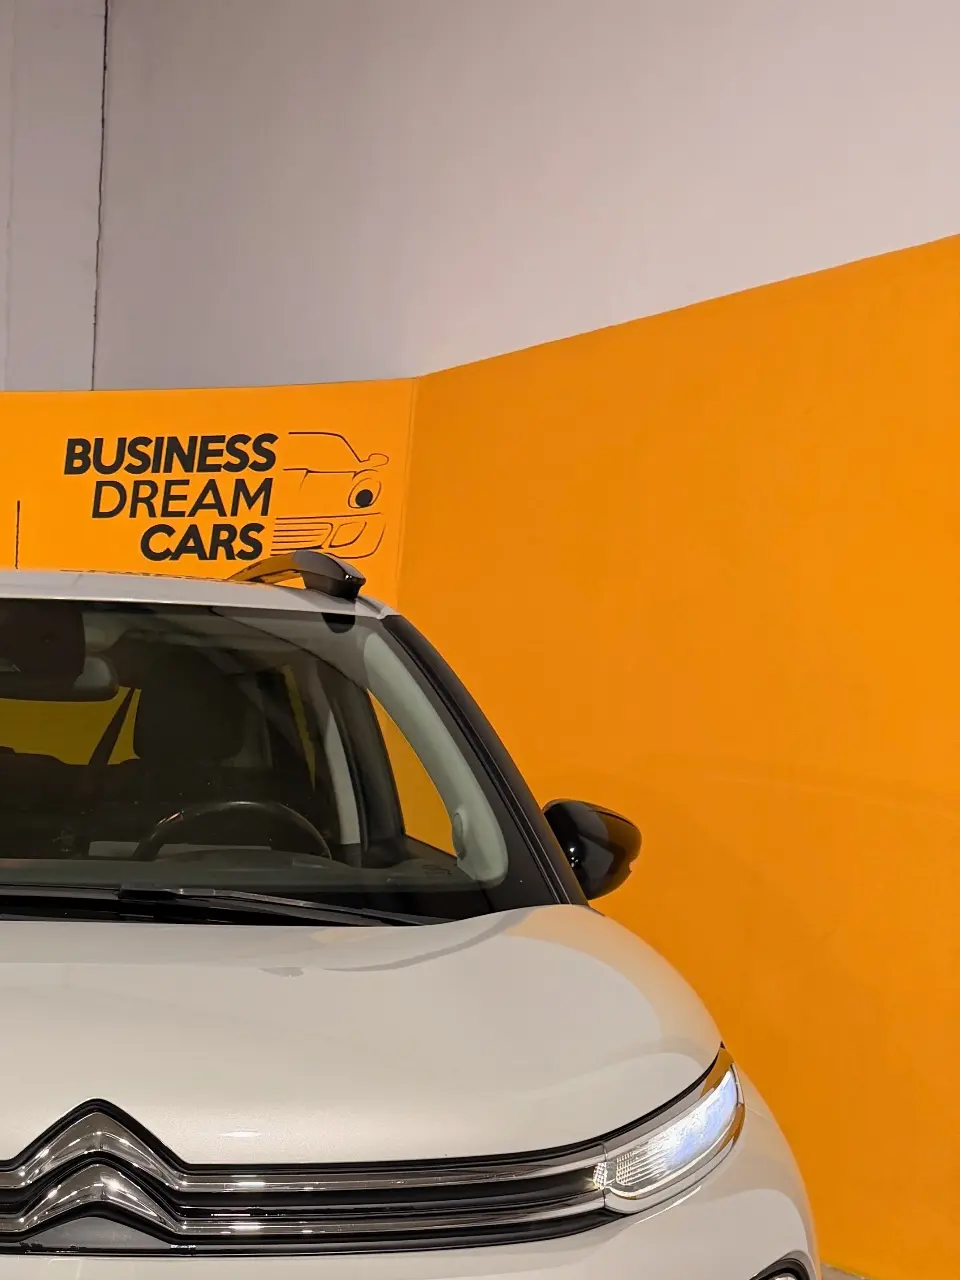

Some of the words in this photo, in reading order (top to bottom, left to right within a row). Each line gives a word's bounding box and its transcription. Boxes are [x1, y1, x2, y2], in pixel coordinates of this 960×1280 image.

[63, 433, 279, 475] BUSINESS
[91, 478, 274, 519] DREAM
[140, 523, 265, 562] CARS
